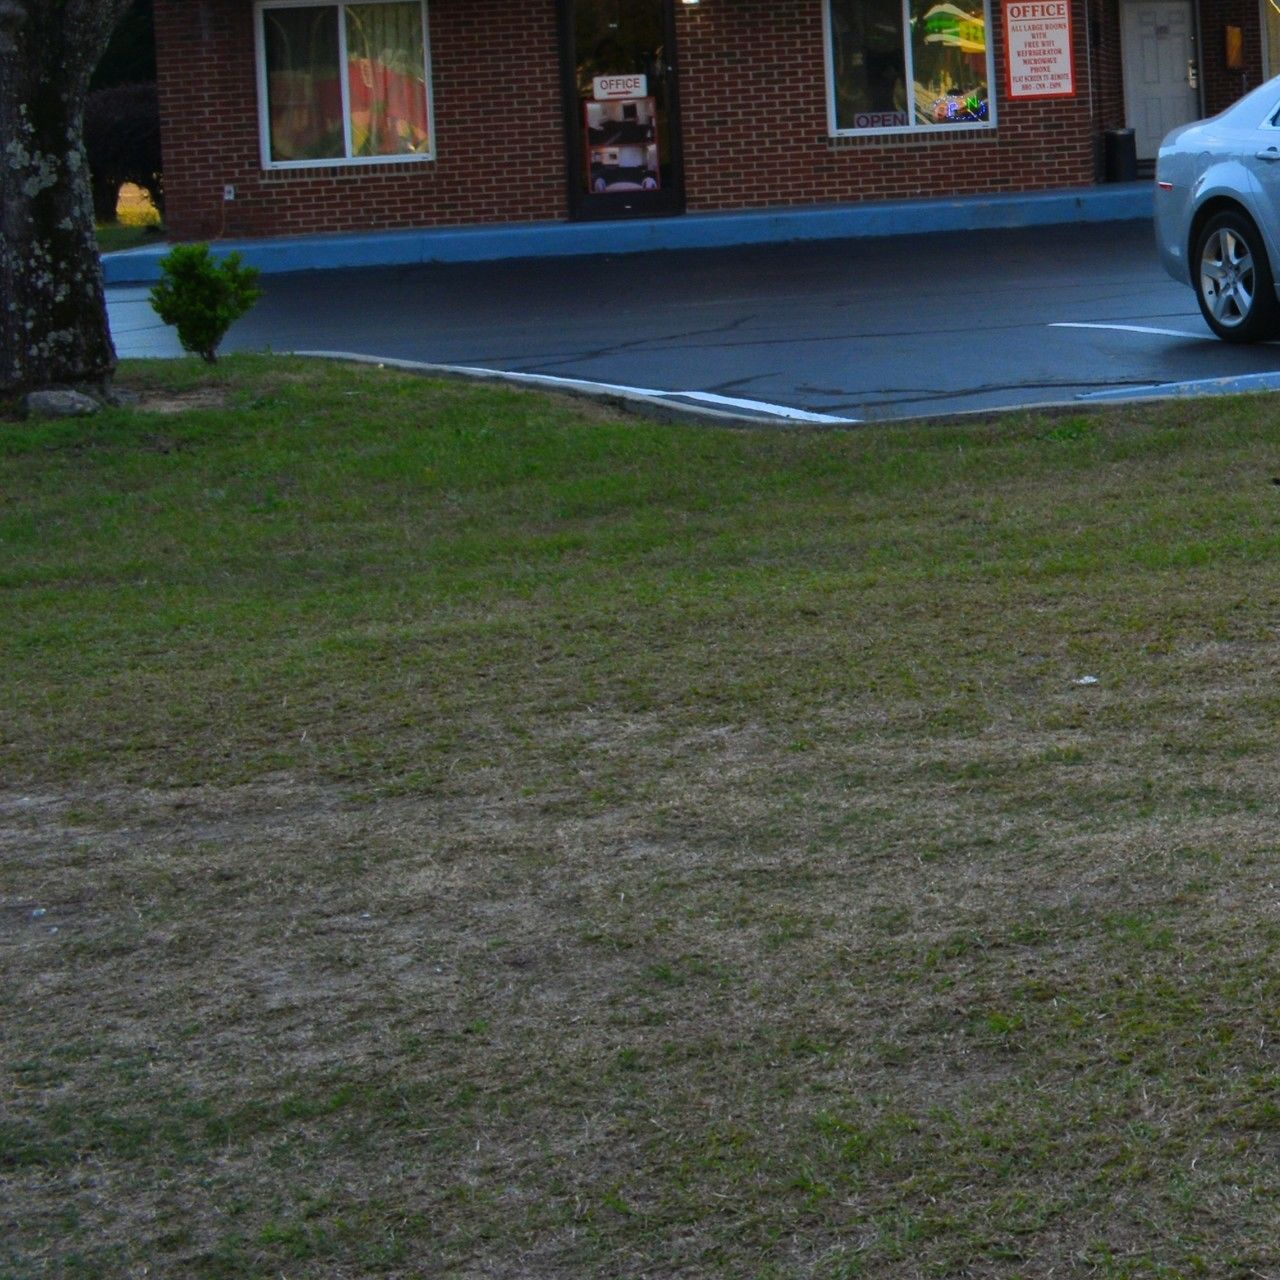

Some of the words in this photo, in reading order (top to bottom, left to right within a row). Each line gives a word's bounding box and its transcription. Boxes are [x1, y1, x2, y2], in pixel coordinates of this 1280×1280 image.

[1010, 4, 1065, 18] OFFICE
[600, 78, 641, 90] OFFICE
[856, 113, 905, 128] OPEN
